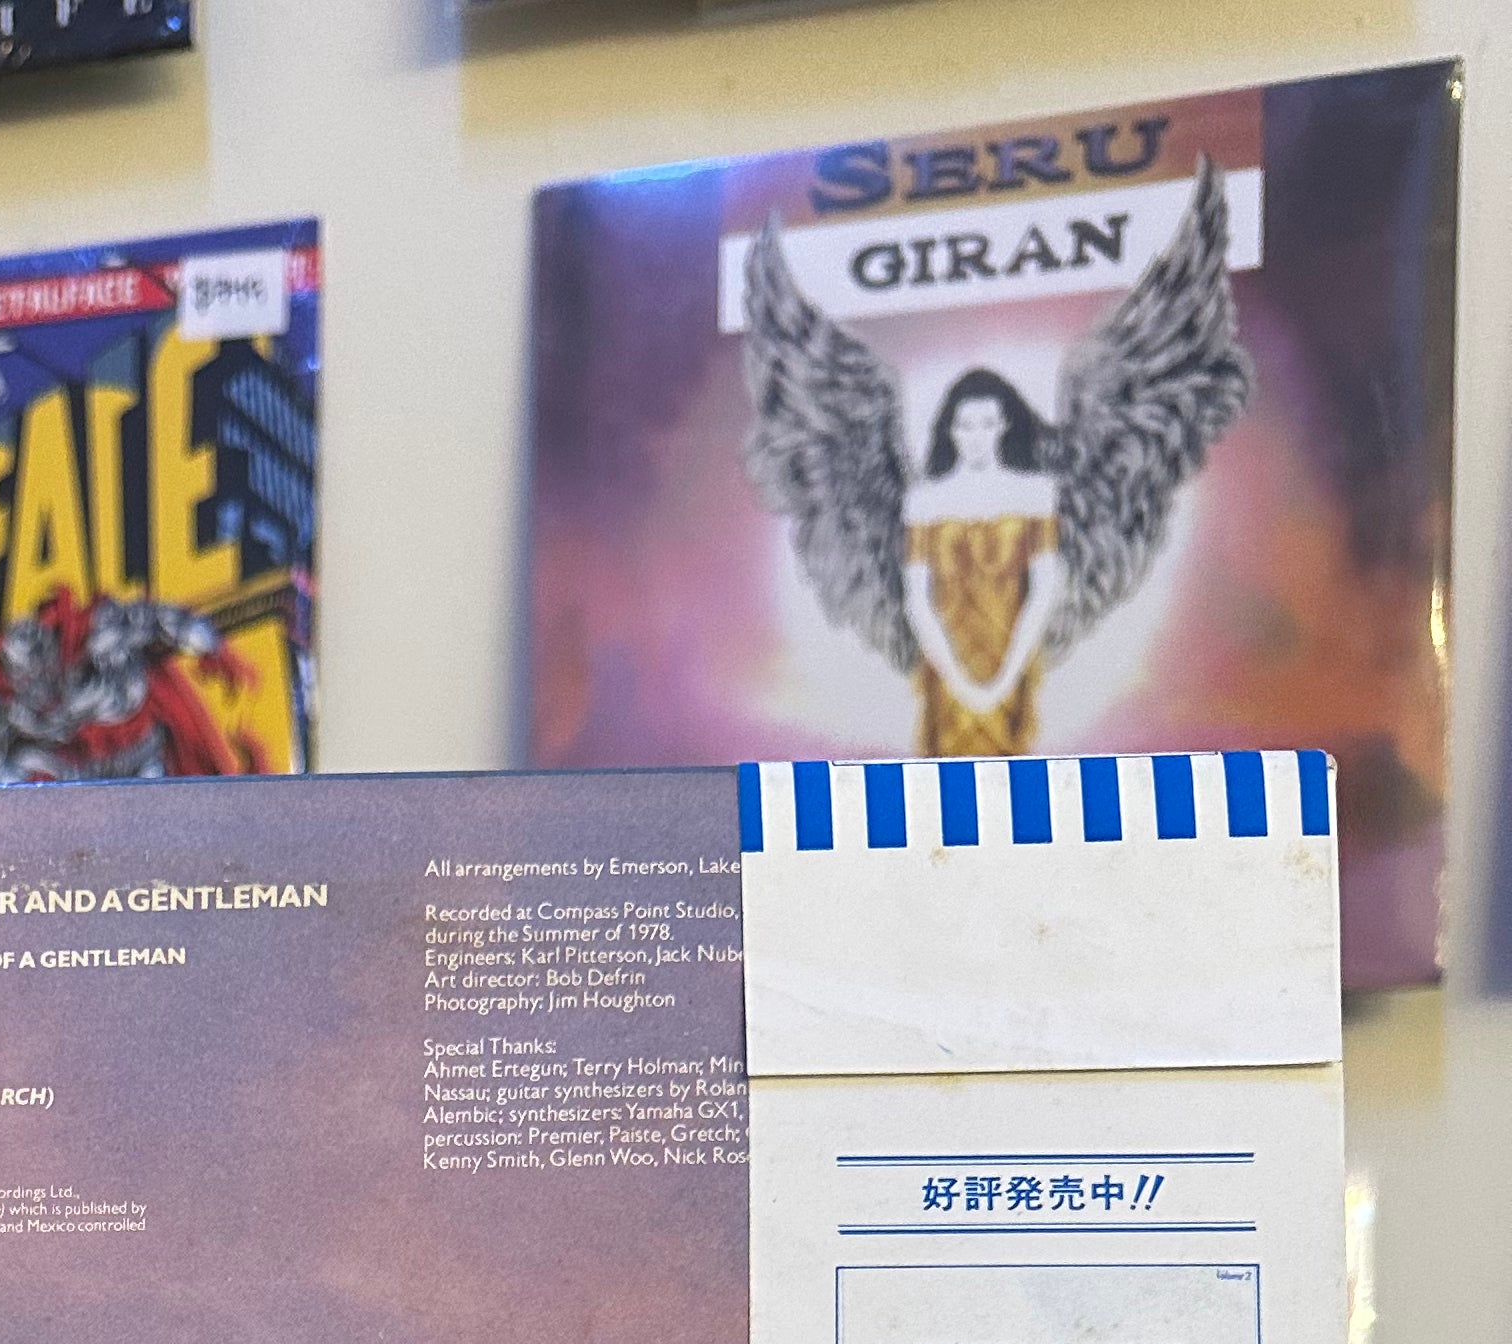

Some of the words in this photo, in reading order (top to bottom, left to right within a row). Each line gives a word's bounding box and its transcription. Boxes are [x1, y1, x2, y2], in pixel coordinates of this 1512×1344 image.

[808, 115, 1170, 215] SERU
[849, 212, 1131, 290] GIRAN
[425, 860, 450, 877] All
[455, 862, 577, 880] arrangements
[584, 858, 603, 879] by
[609, 859, 693, 876] Emerson,
[699, 858, 741, 873] Lake
[24, 890, 96, 914] AND
[101, 889, 123, 912] A
[128, 884, 328, 912] GENTLEMAN
[425, 905, 511, 921] Recorded
[517, 905, 532, 920] at
[538, 903, 618, 923] Compass
[624, 903, 670, 918] Point
[675, 901, 739, 920] Studio,
[425, 928, 484, 947] during
[489, 928, 518, 943] the
[522, 926, 600, 943] Summer
[605, 924, 621, 940] of
[629, 924, 674, 940] 1978.
[19, 951, 36, 969] A
[41, 948, 186, 968] GENTLEMAN
[425, 972, 456, 988] Art
[463, 972, 539, 988] director:
[546, 971, 581, 986] Bob
[588, 970, 645, 985] Defrin
[425, 994, 543, 1014] Photography:
[548, 993, 577, 1012] Jim
[583, 992, 675, 1012] Houghton
[424, 1039, 484, 1059] Special
[489, 1038, 556, 1054] Thanks:
[1245, 1272, 1252, 1280] 2
